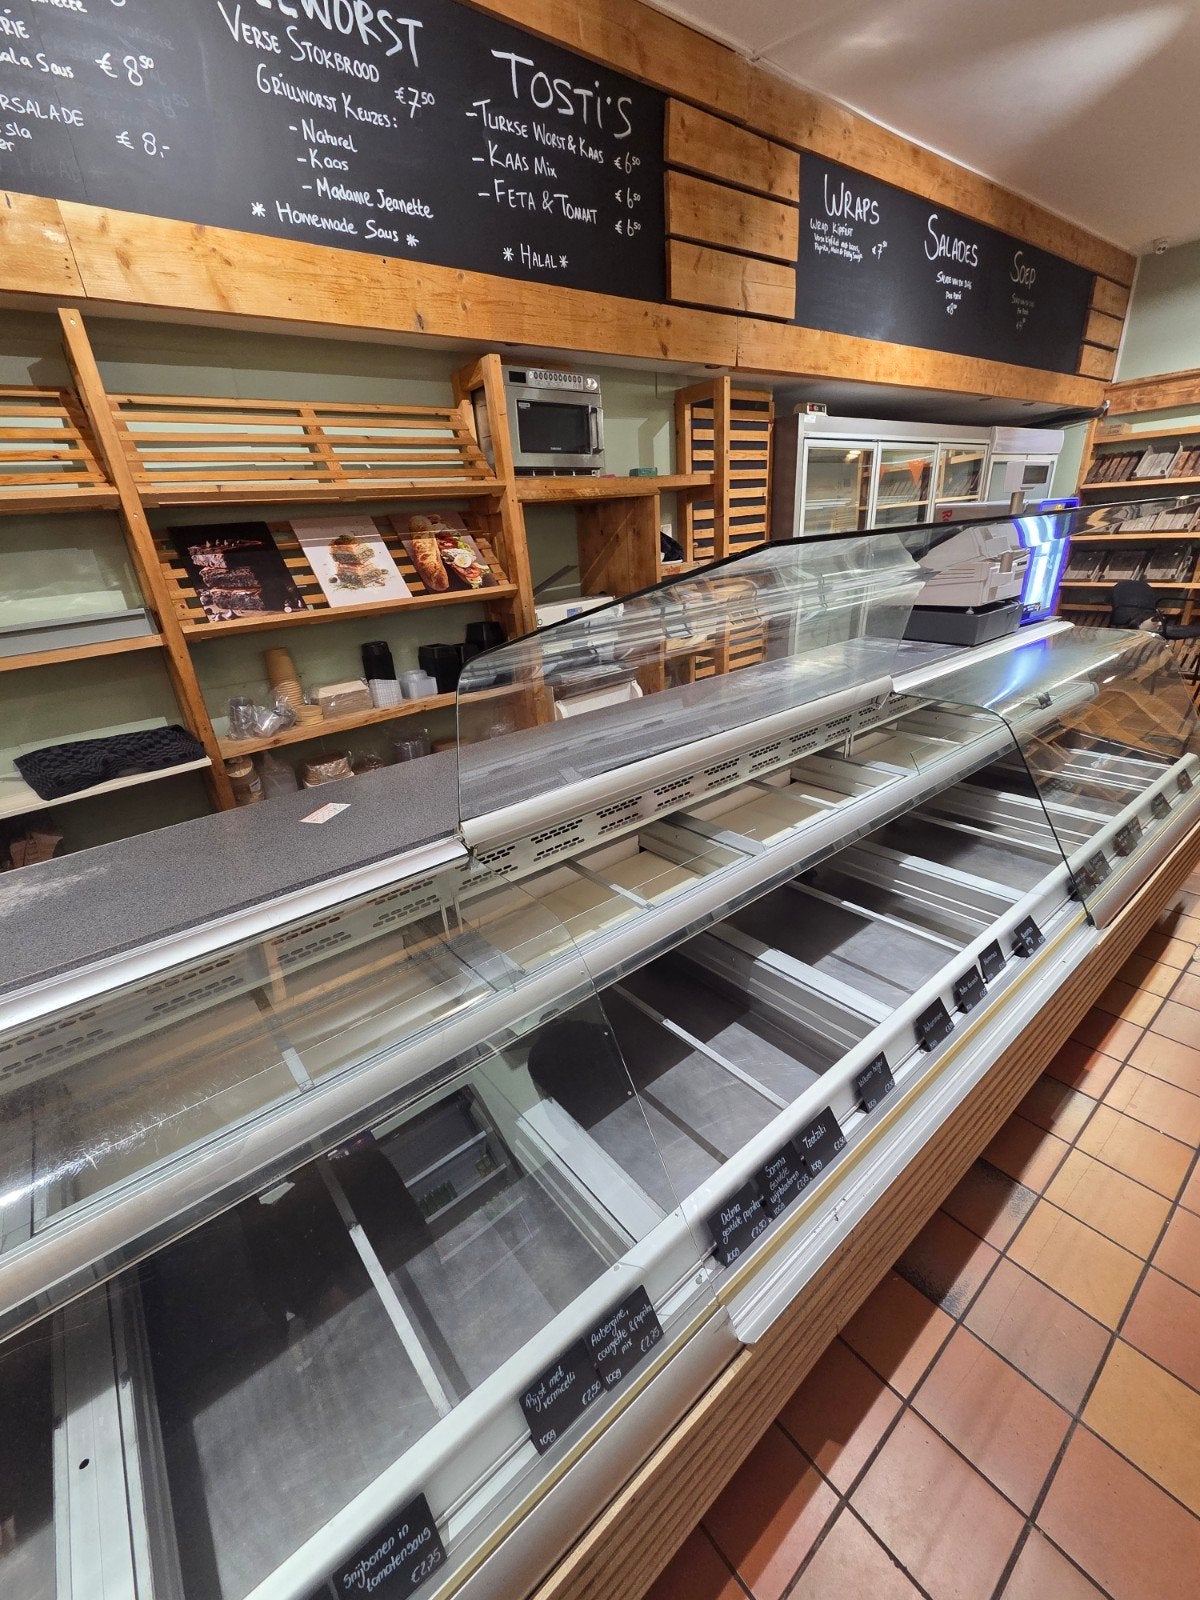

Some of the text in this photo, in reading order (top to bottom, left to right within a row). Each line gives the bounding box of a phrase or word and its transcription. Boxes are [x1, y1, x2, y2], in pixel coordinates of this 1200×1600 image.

[0, 16, 30, 38] RIE
[36, 53, 74, 79] Saus
[5, 122, 32, 139] sla
[488, 140, 530, 171] KAAS
[316, 177, 373, 206] Madame
[494, 179, 536, 210] FETA
[824, 173, 880, 225] WRAPS
[924, 214, 978, 267] SALADES
[520, 243, 557, 269] HALAL
[549, 1365, 564, 1388] met
[398, 1523, 409, 1541] in
[411, 1547, 441, 1584] €2,75
